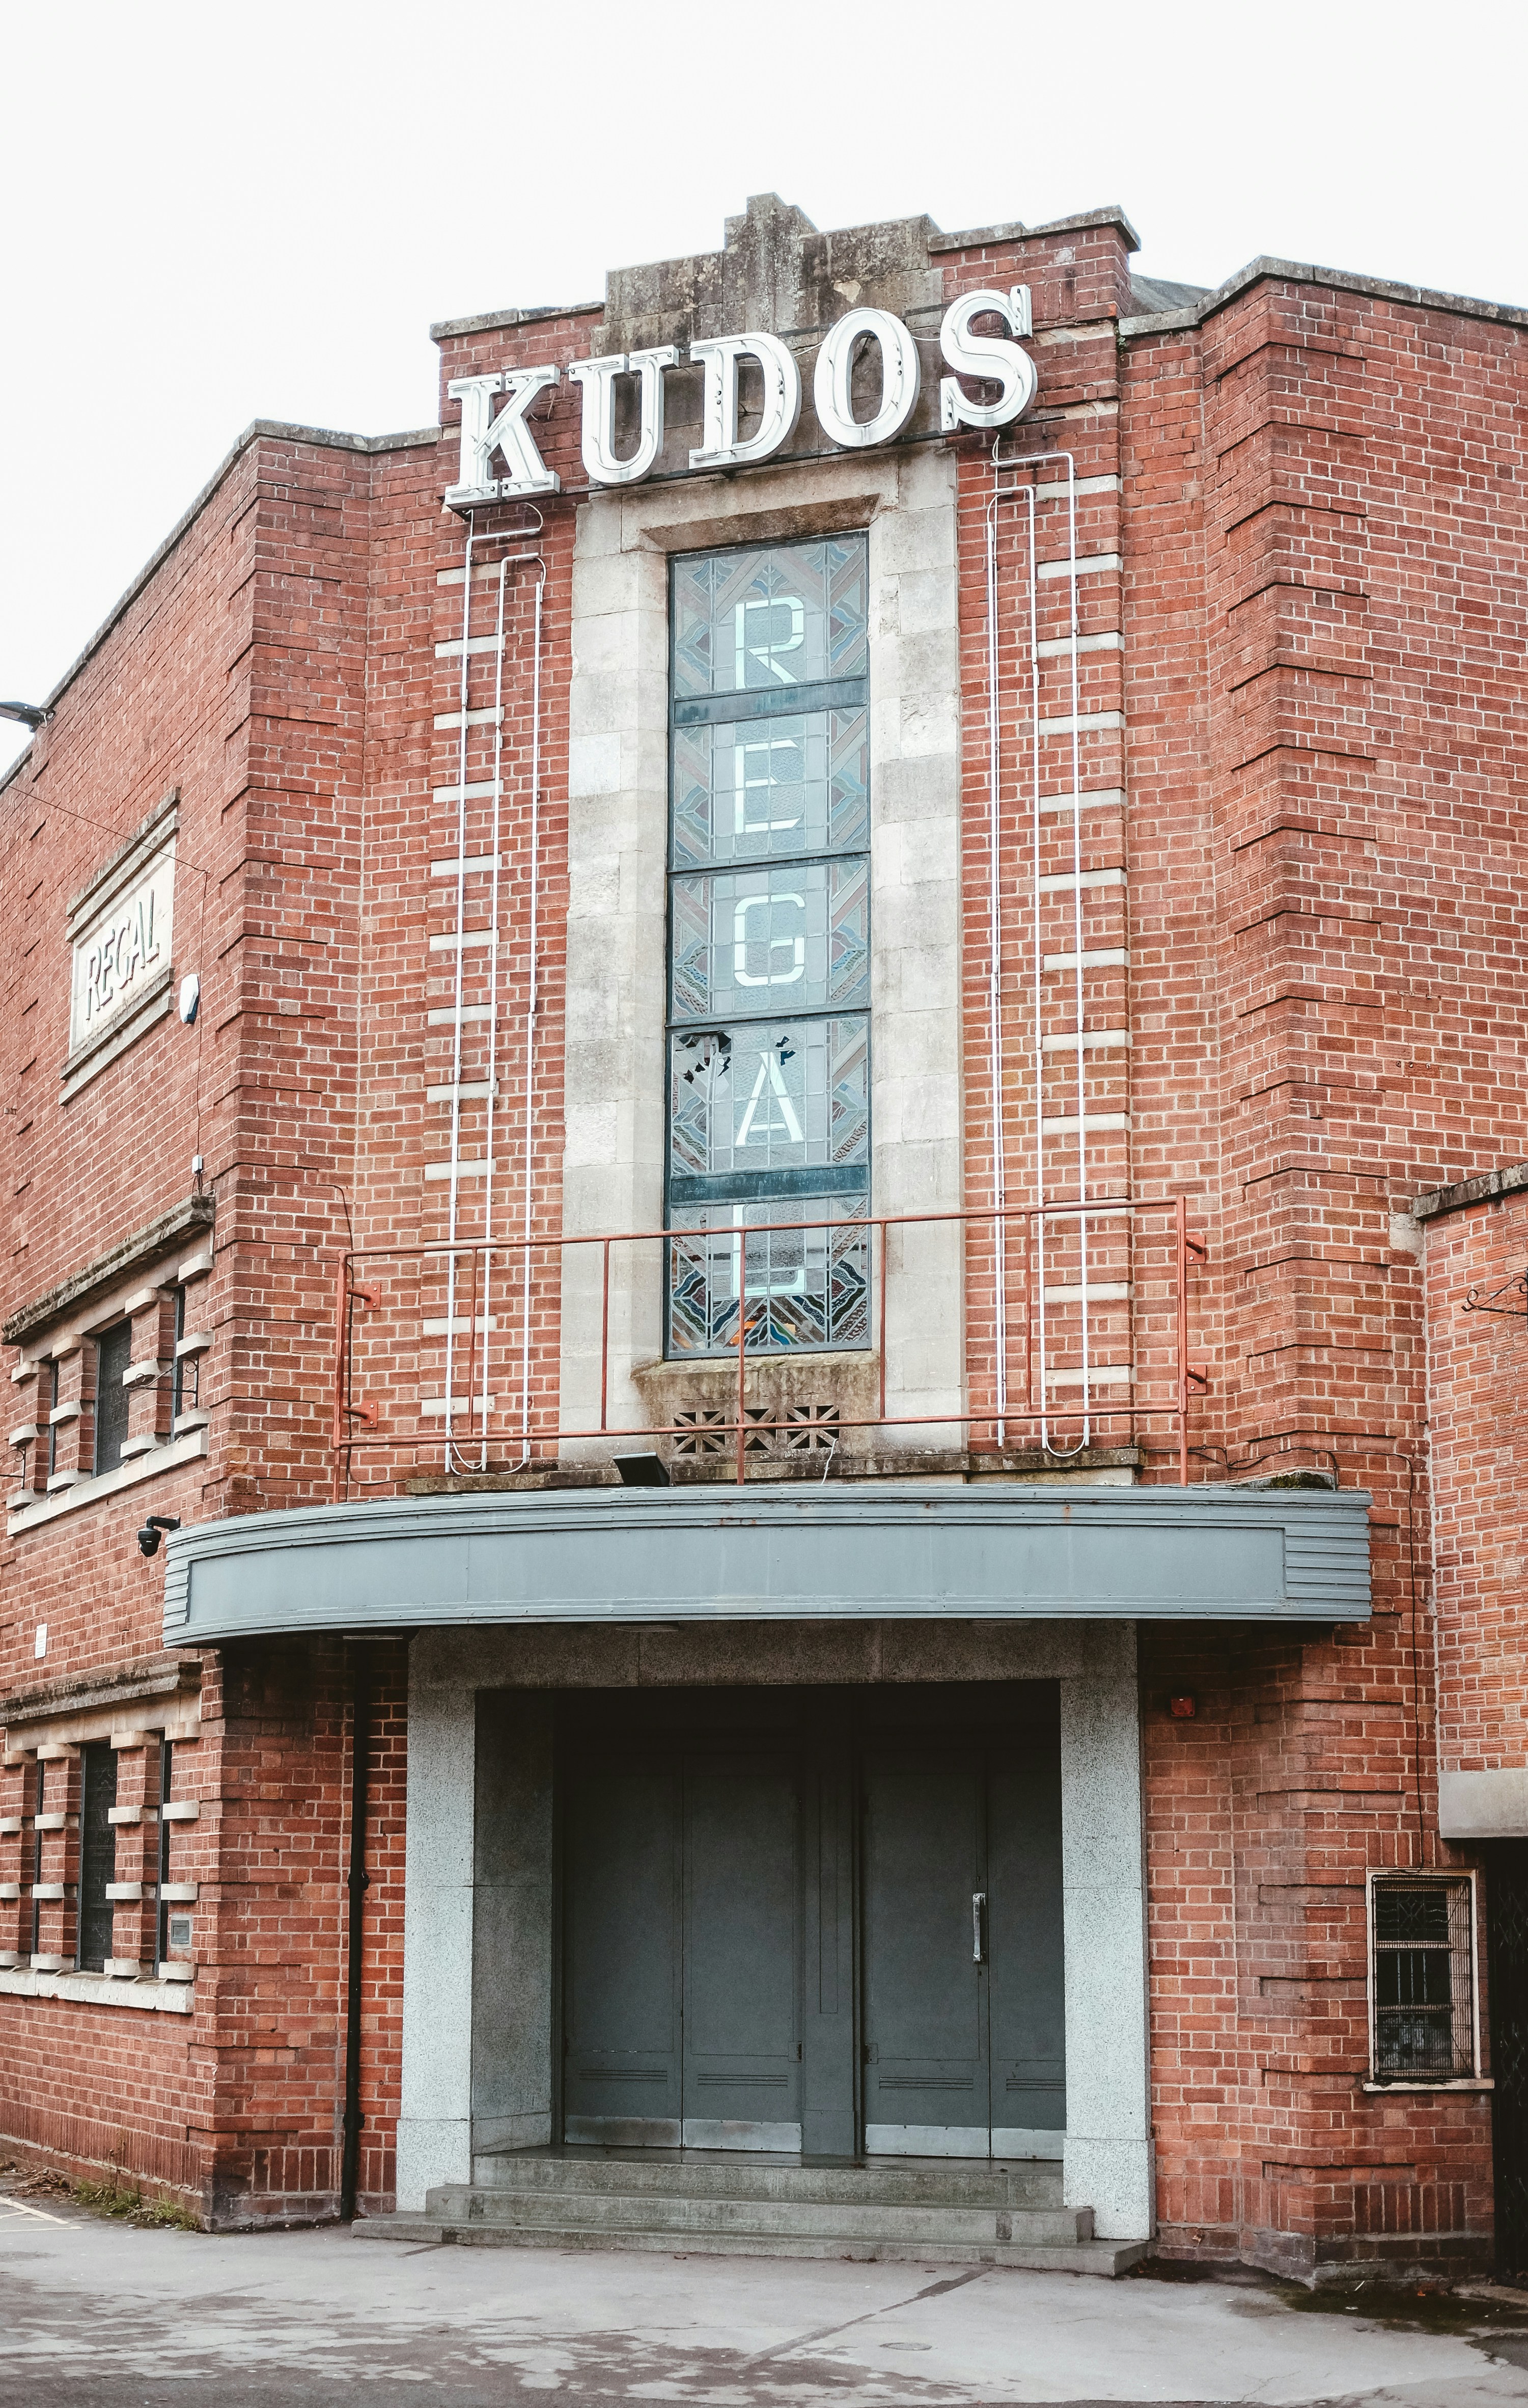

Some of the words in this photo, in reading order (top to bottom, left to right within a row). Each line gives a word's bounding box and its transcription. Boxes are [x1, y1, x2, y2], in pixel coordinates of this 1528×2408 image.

[445, 285, 1038, 507] KUDOS
[86, 888, 159, 1021] REGAL
[734, 595, 805, 1298] REGAL
